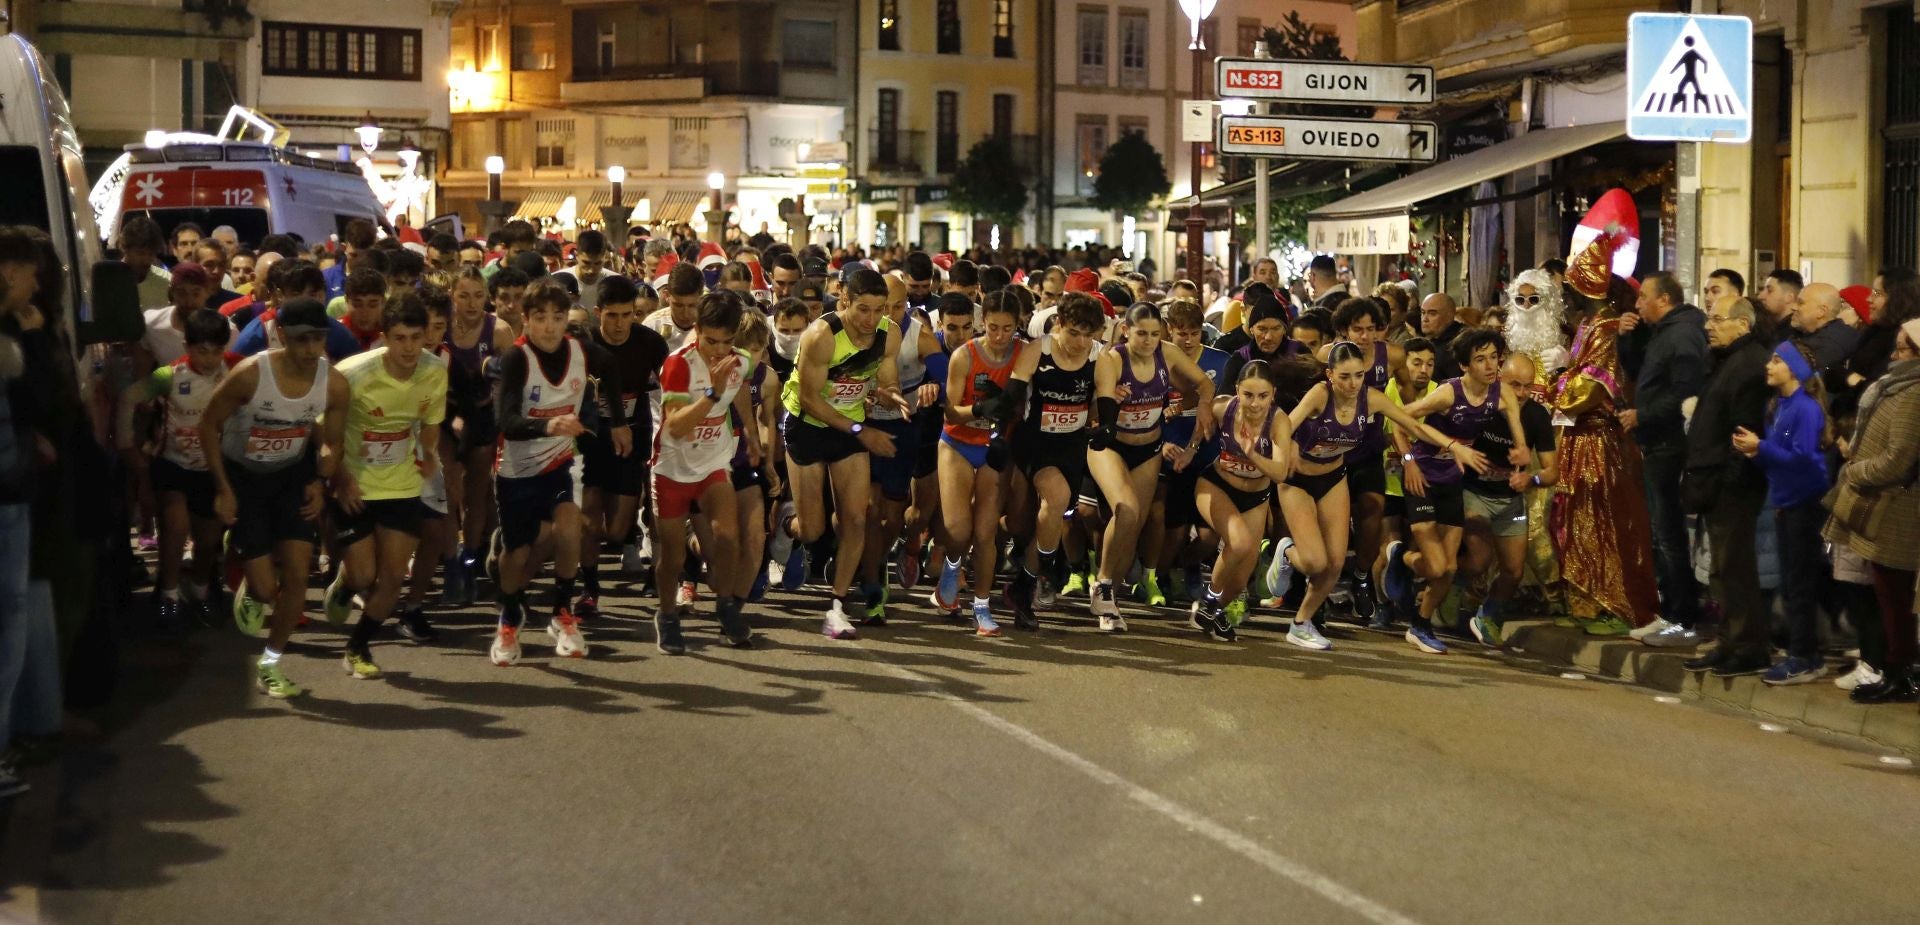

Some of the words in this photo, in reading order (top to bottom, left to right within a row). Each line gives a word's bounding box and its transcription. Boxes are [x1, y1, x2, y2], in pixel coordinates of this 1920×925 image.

[1229, 72, 1279, 87] N-632
[1305, 74, 1367, 90] GIJON
[1231, 129, 1282, 143] AS-113
[1301, 130, 1380, 148] OVIEDO
[222, 188, 253, 206] 112
[837, 384, 864, 395] 259
[1051, 413, 1078, 424] 165
[1131, 411, 1149, 422] 32
[696, 427, 721, 439] 184
[257, 439, 292, 451] 201
[382, 442, 392, 454] 7
